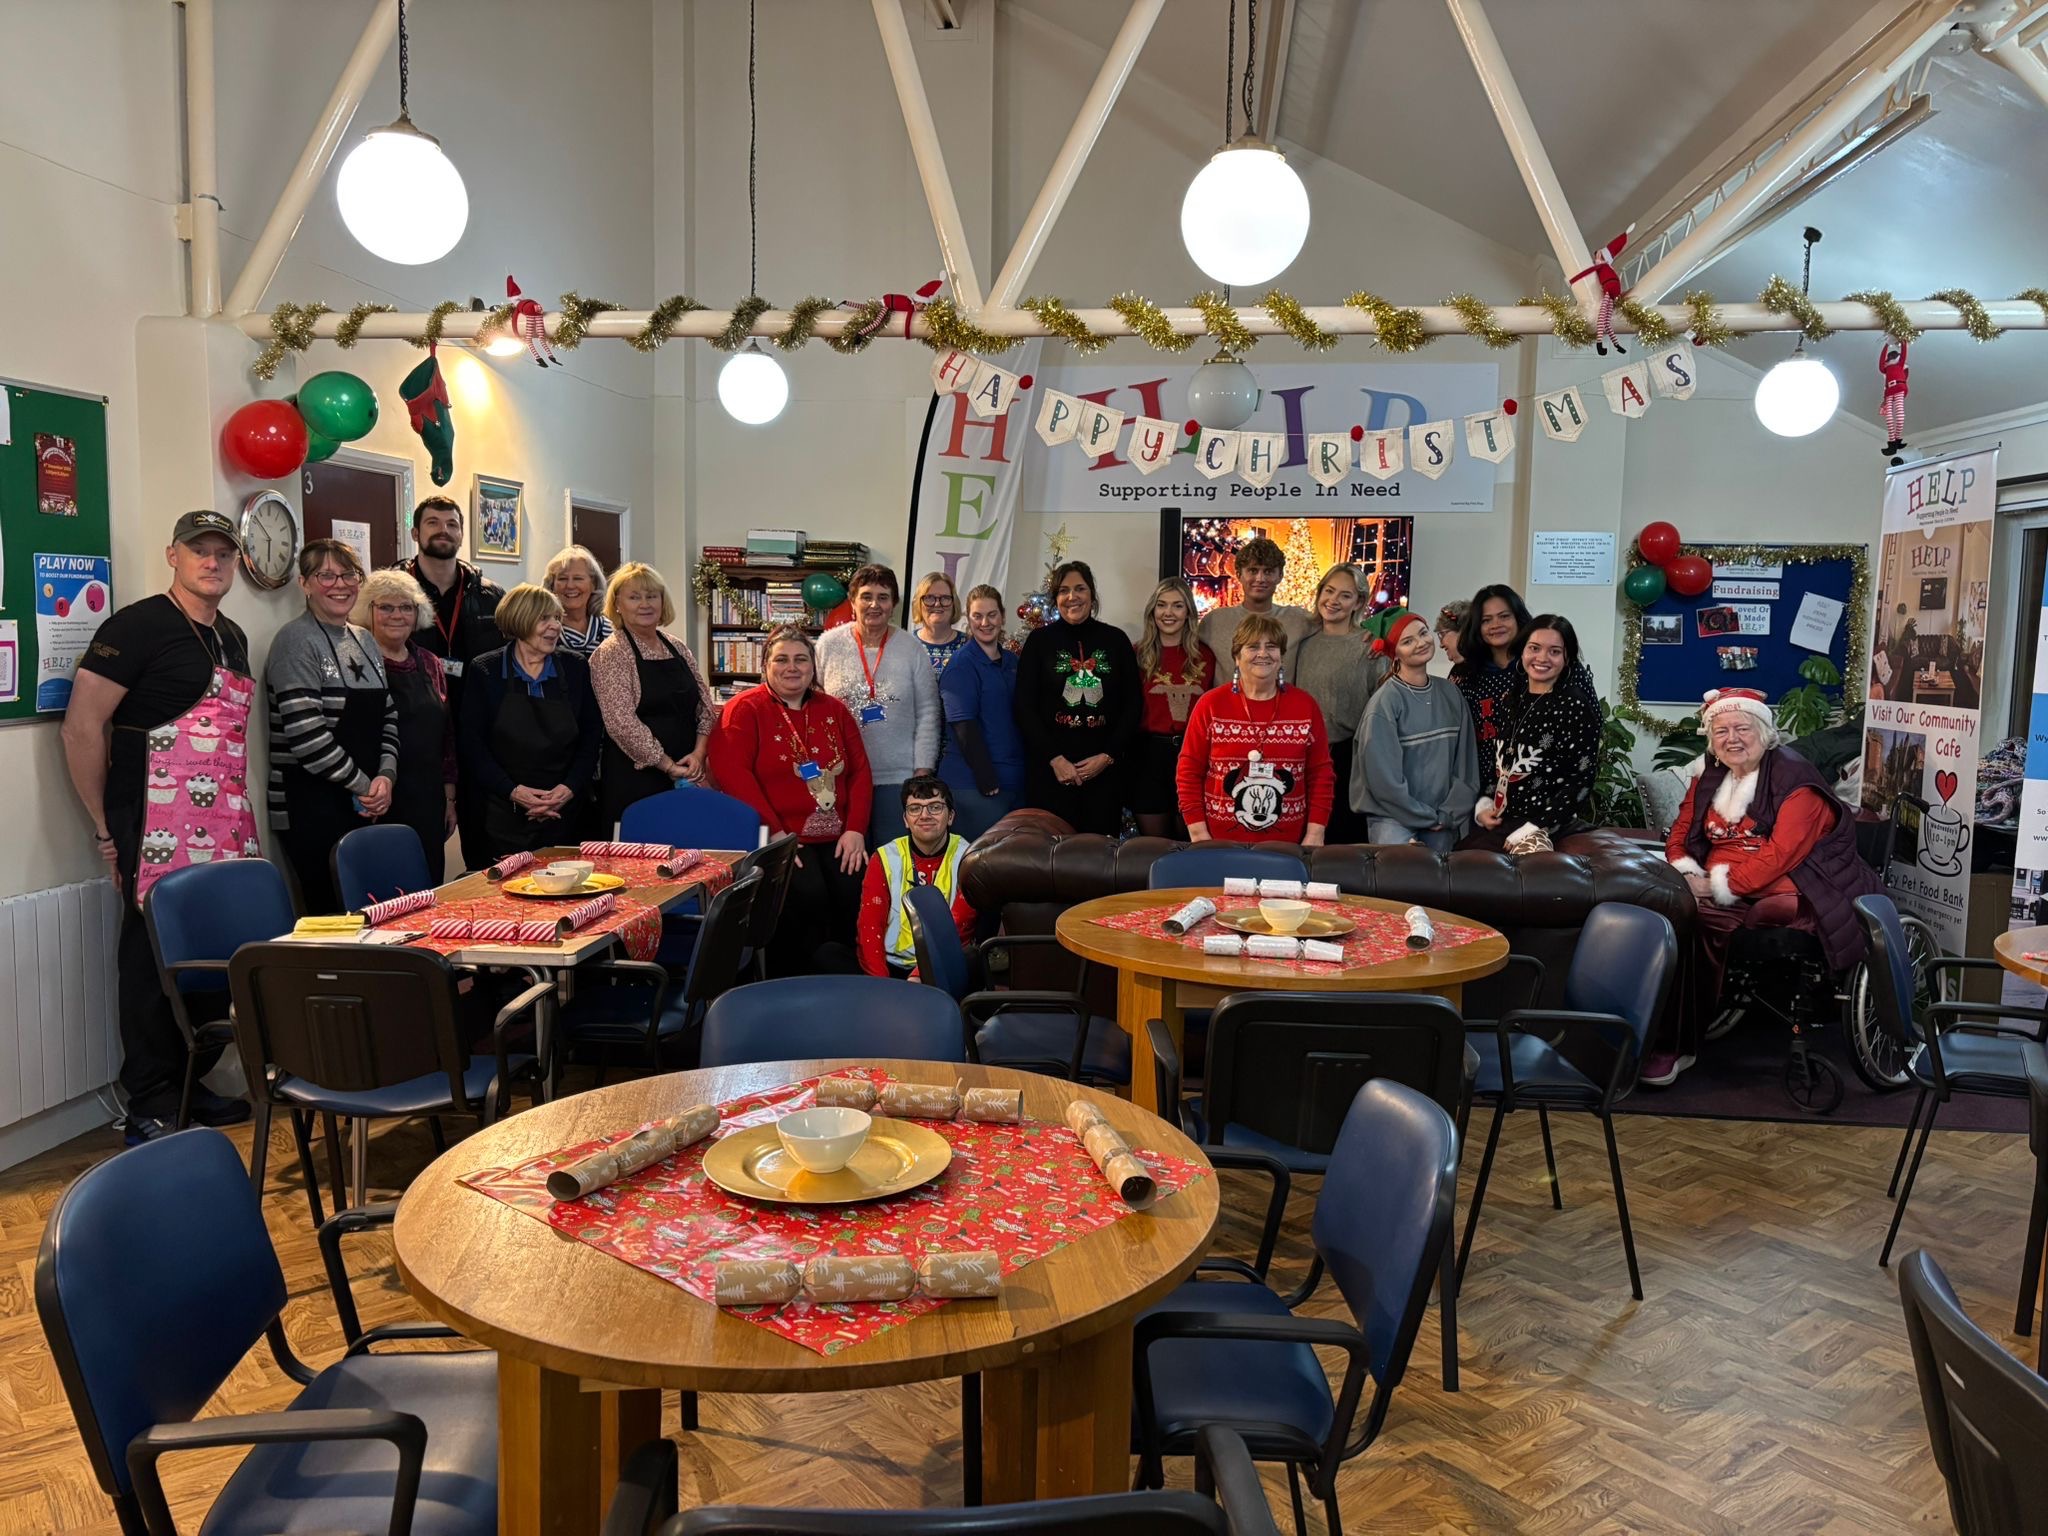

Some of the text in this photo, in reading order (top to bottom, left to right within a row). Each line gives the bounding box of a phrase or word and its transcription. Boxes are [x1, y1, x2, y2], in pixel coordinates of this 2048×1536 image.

[304, 471, 314, 494] 3
[1099, 482, 1401, 500] Supporting People In Need
[1907, 467, 1975, 515] HELP
[338, 528, 366, 539] HELP
[39, 556, 95, 571] PLAY NOW
[1911, 544, 1951, 569] HELP
[1713, 585, 1779, 597] Fundraising
[1744, 614, 1766, 622] Made
[43, 656, 73, 669] HELP
[1872, 704, 1976, 737] Visit Our Community
[1935, 737, 1961, 758] Cafe
[1902, 874, 1917, 891] Pet
[1920, 881, 1940, 899] Food
[1943, 888, 1964, 908] Bank
[1953, 916, 1962, 925] pet
